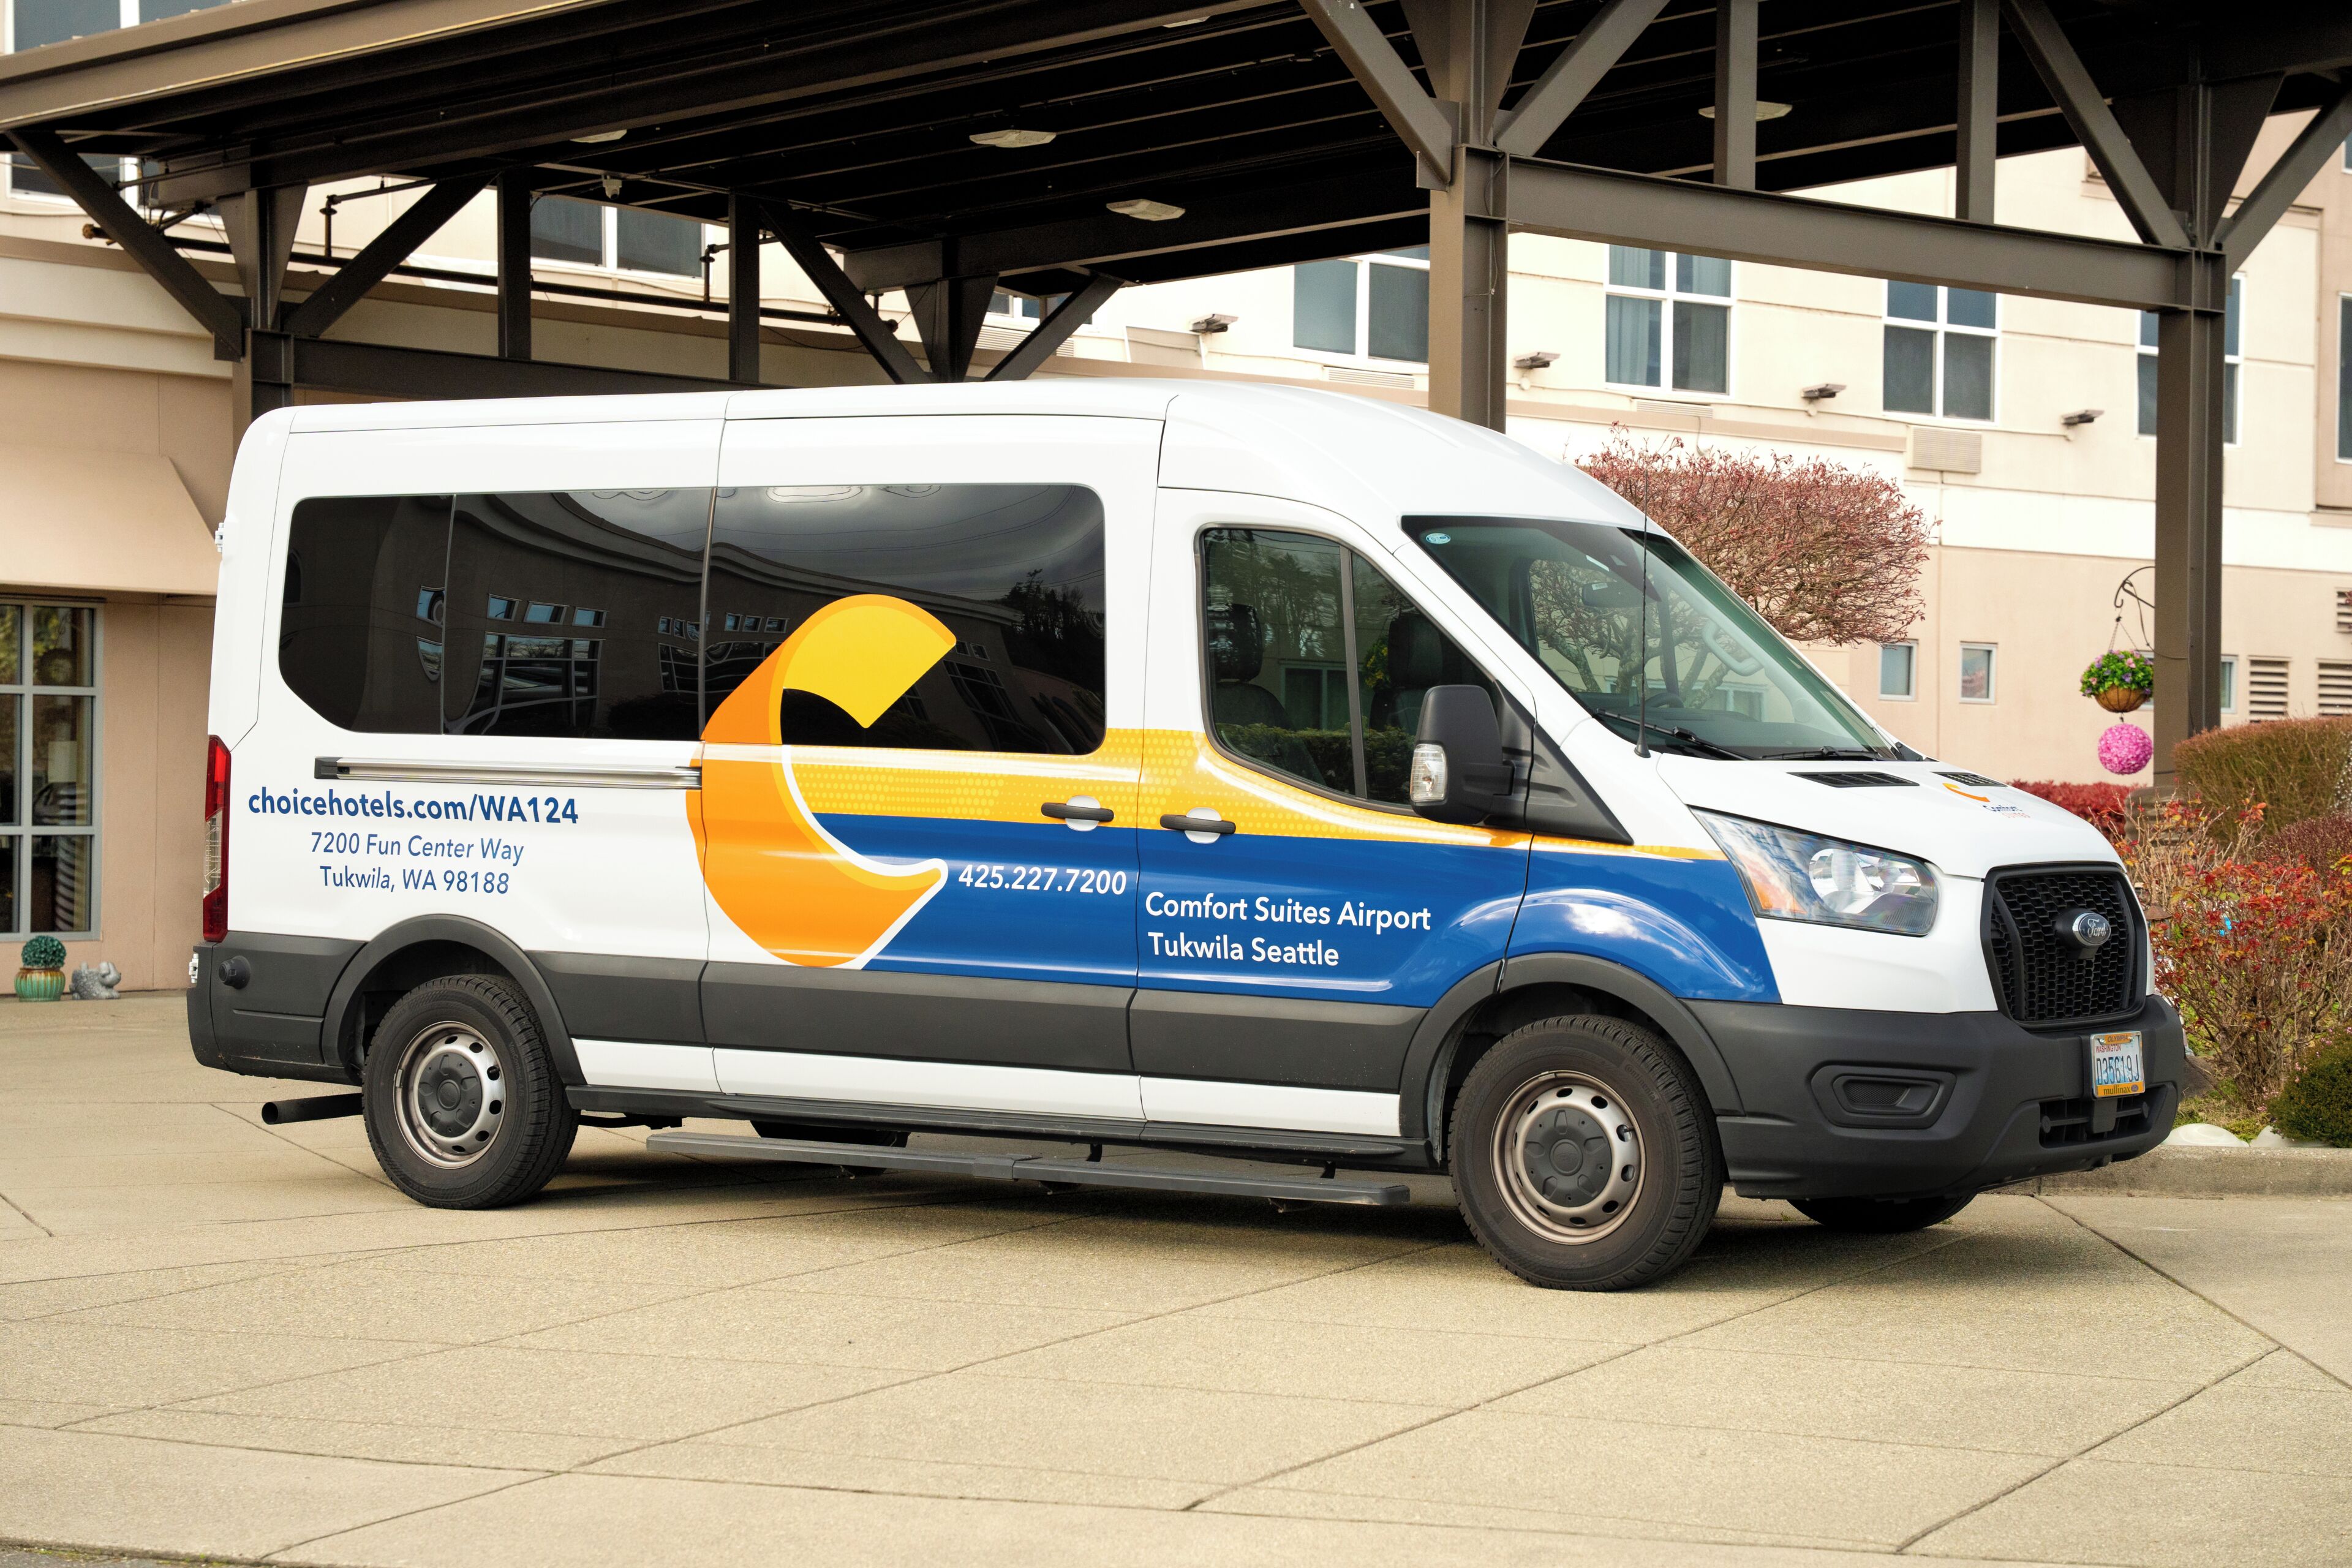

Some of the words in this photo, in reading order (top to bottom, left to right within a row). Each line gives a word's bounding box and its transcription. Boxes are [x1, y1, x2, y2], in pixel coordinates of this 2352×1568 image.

[248, 786, 579, 824] choicehotels.com/WA124
[311, 832, 360, 854] 7200
[366, 834, 401, 856] Fun
[408, 835, 475, 858] Center
[480, 837, 524, 867] Way
[320, 865, 395, 892] Tukwila,
[402, 869, 437, 891] WA
[443, 870, 509, 894] 98188
[958, 864, 1127, 895] 425.227.7200
[1145, 891, 1248, 921] Comfort
[1254, 896, 1330, 925] Suites
[1336, 901, 1431, 935] Airport
[2087, 918, 2107, 938] Ford
[1148, 932, 1243, 960] Tukwila
[1251, 937, 1339, 966] Seattle
[2096, 1044, 2121, 1054] WASHINGTON
[2096, 1054, 2139, 1085] D35619J
[2103, 1084, 2132, 1095] mullinax
